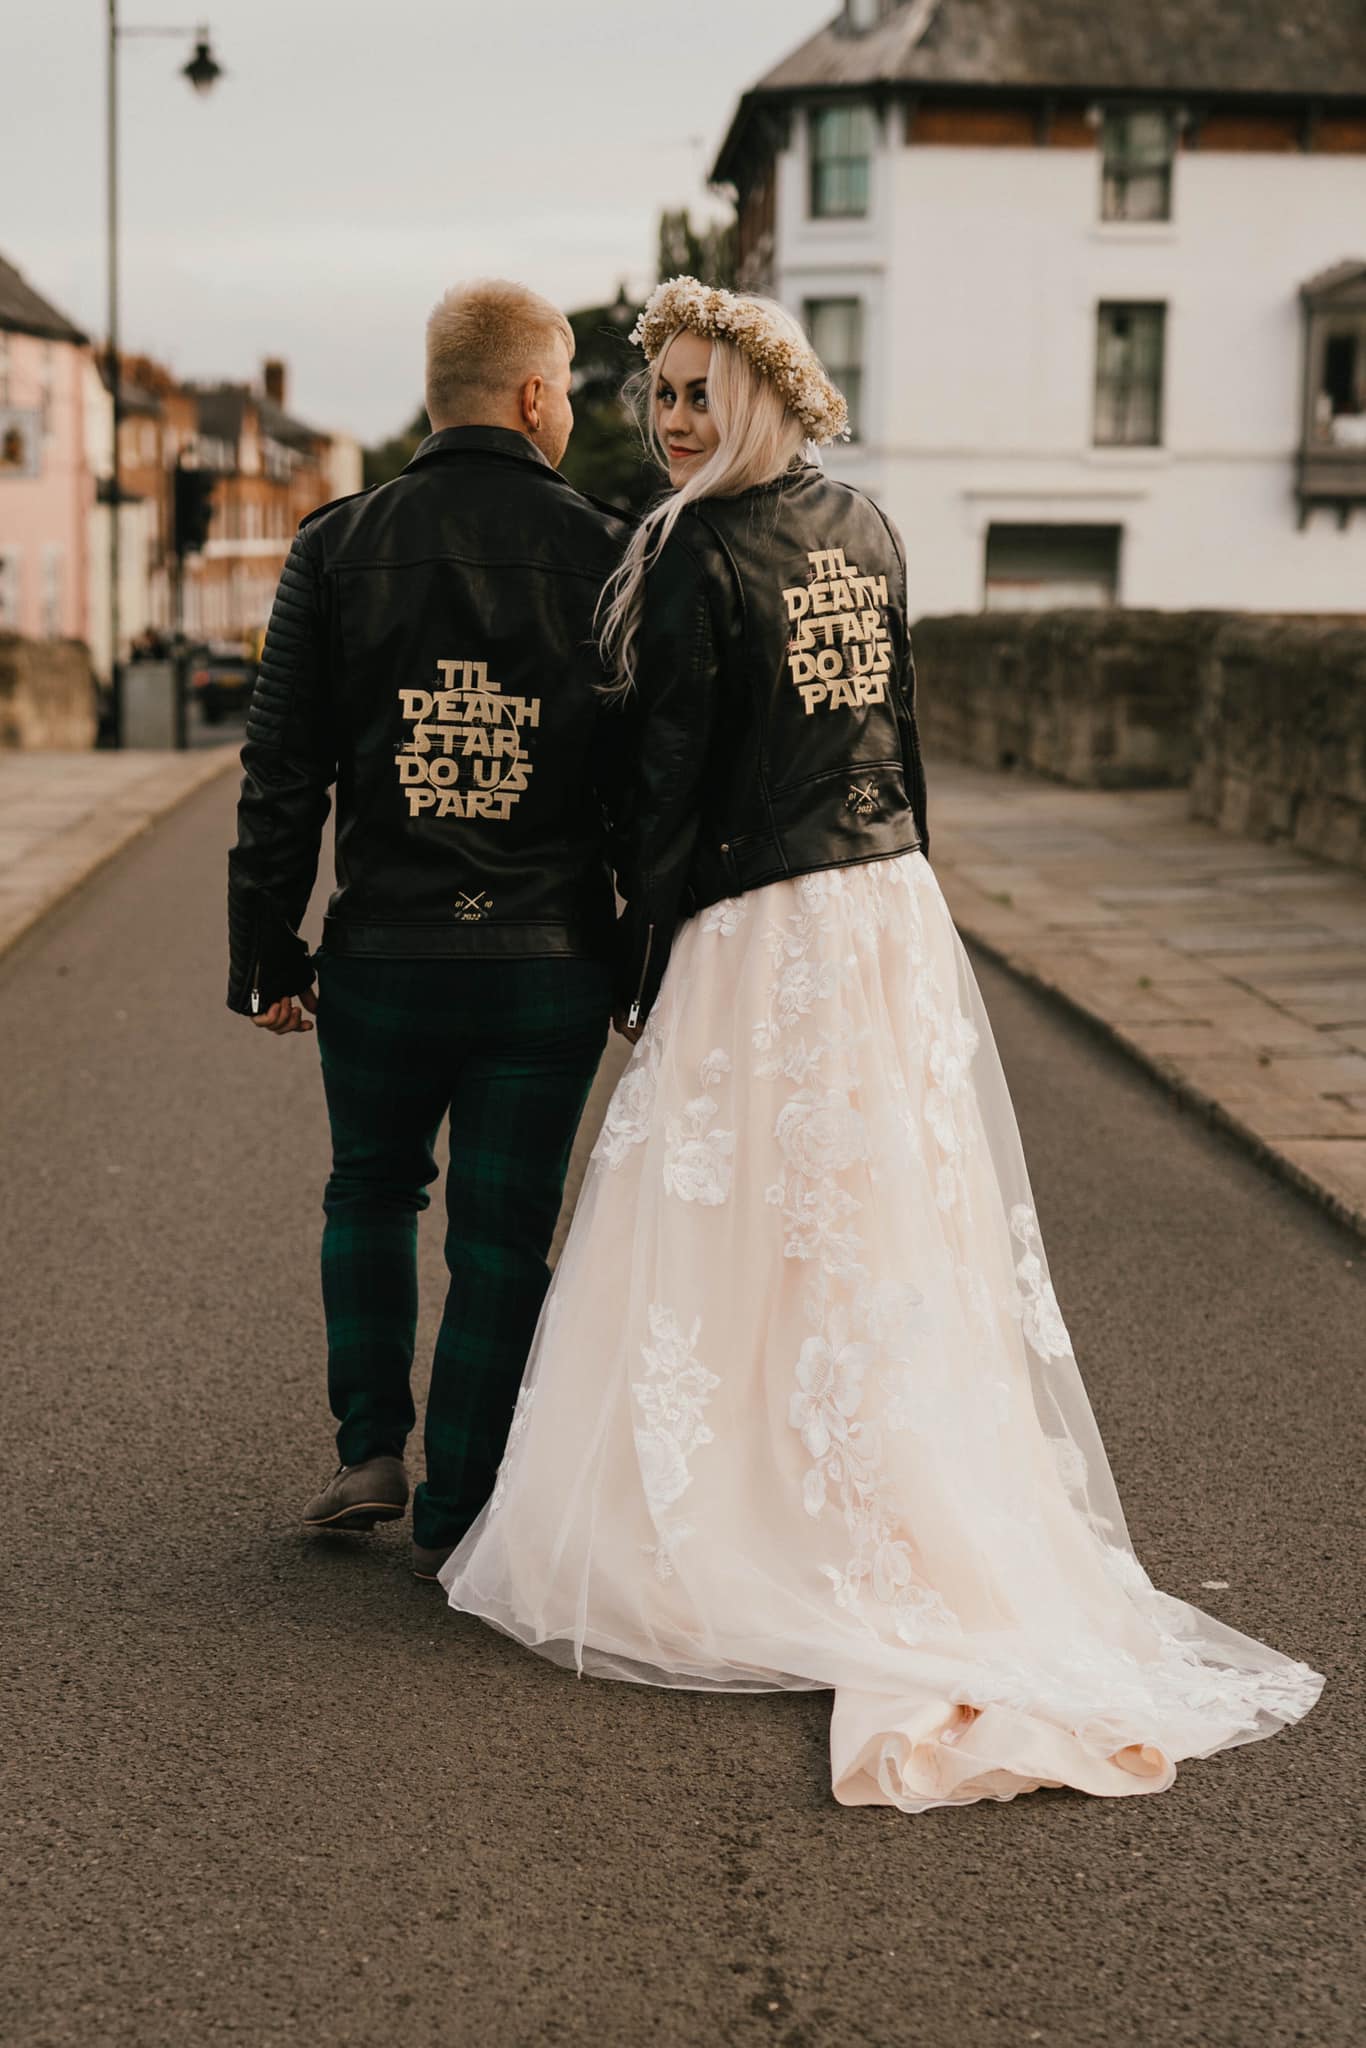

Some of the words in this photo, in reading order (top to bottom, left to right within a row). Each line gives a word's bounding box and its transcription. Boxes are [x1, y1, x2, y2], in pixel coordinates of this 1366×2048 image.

[807, 548, 858, 581] TIL
[782, 575, 889, 621] DEATH
[789, 610, 887, 650] STAR
[437, 659, 501, 692] TIL
[788, 648, 843, 684] DO
[851, 642, 891, 674] US
[398, 689, 541, 727] DEATH
[798, 673, 889, 715] PART
[402, 724, 529, 760] STAR
[395, 755, 459, 786] DO
[473, 759, 533, 791] US
[405, 788, 520, 820] PART
